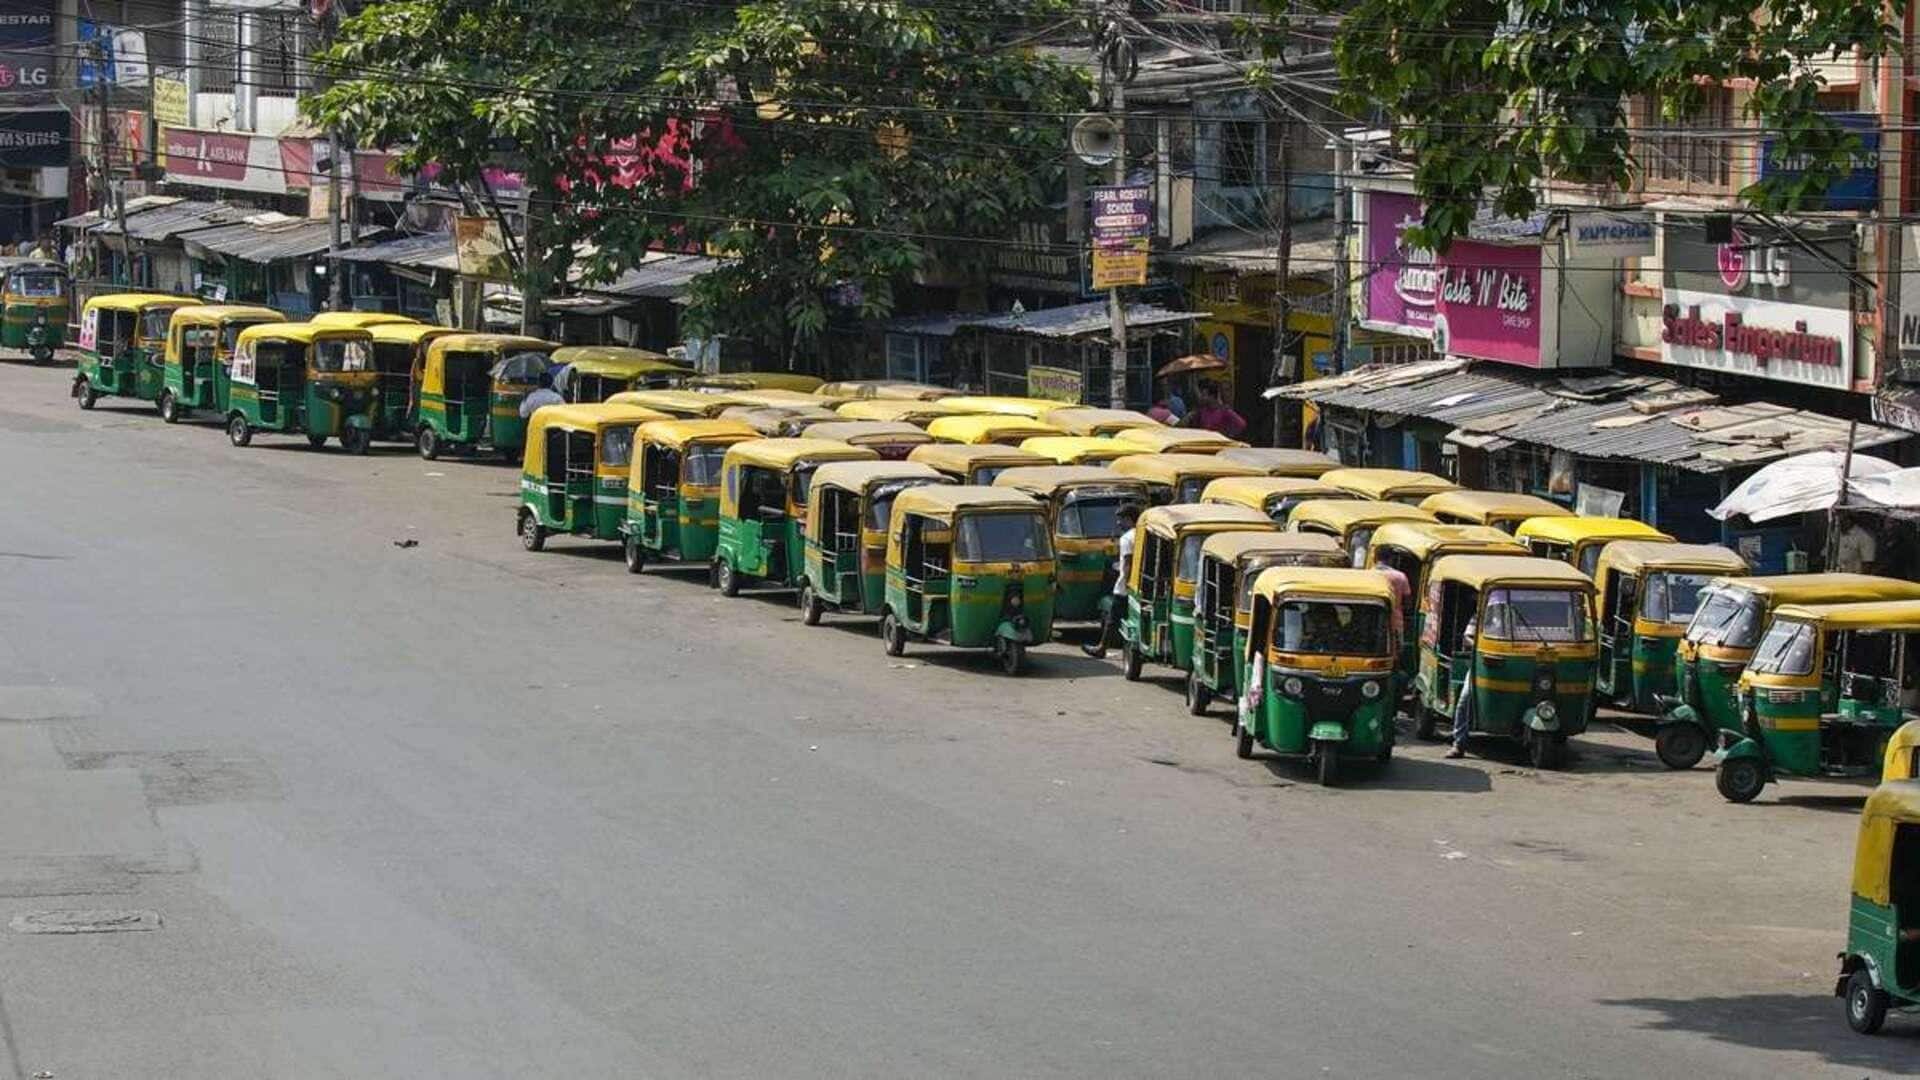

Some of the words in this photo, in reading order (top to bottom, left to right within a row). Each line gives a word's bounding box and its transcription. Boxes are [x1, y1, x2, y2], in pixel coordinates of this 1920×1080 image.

[19, 68, 47, 84] LG
[1094, 190, 1118, 202] PEARL
[1120, 189, 1148, 201] ROSARY
[1106, 203, 1135, 214] SCHOOL
[1750, 235, 1791, 288] LG
[1437, 266, 1471, 304] Taste
[1476, 268, 1496, 306] 'N'
[1497, 272, 1528, 312] Bite
[1662, 303, 1720, 350] Sales
[1724, 312, 1841, 367] Emporium
